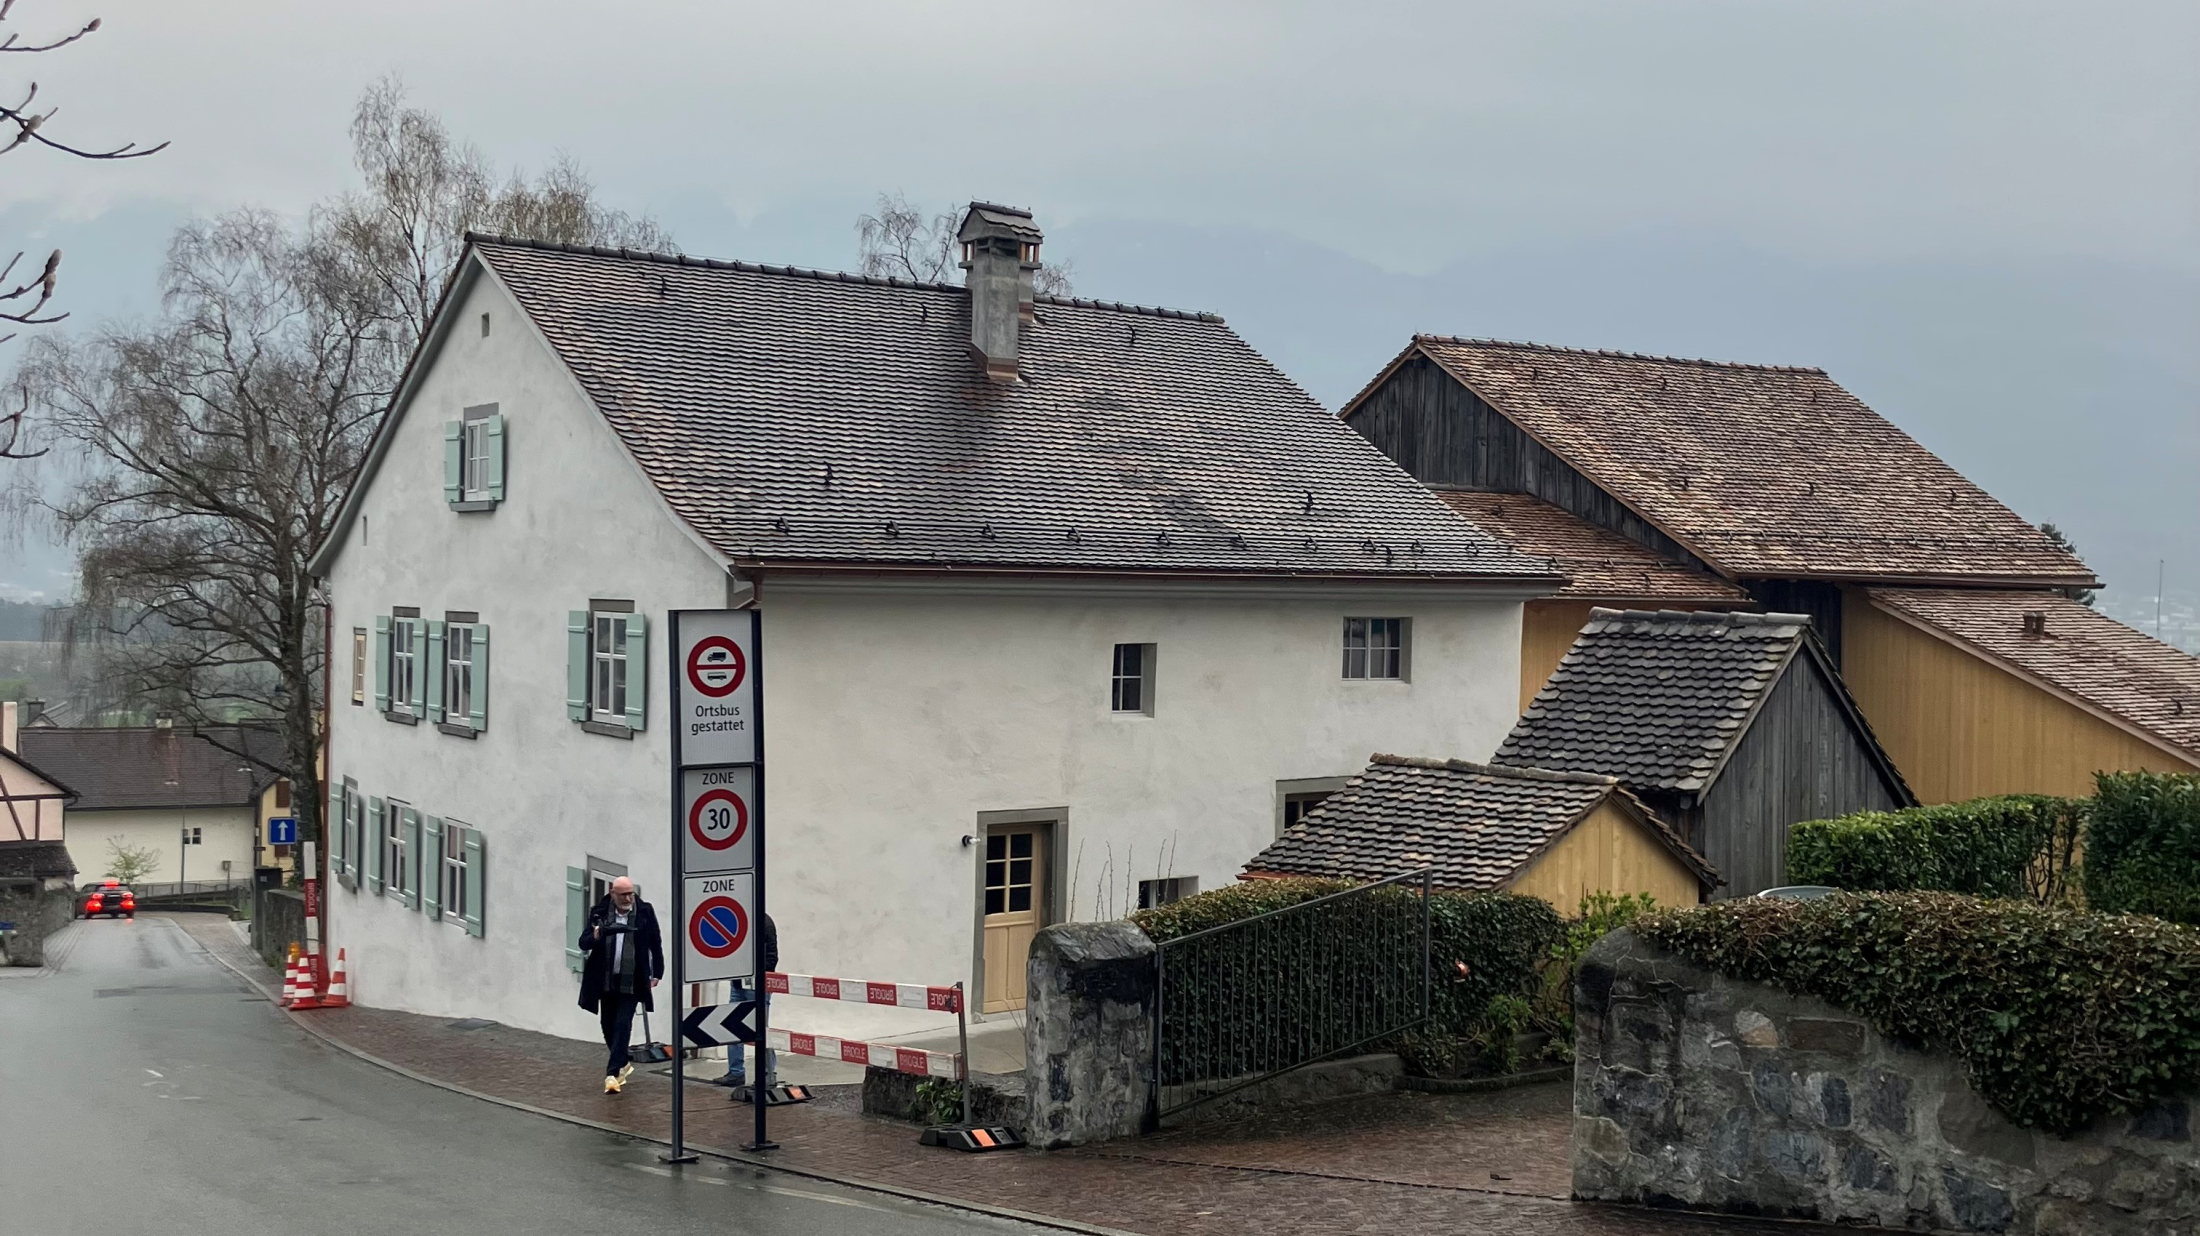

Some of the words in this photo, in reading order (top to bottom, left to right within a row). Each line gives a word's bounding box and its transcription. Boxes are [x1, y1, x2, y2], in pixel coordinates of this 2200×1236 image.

[695, 704, 740, 717] Ortsbus
[691, 719, 744, 736] gestattet
[702, 772, 735, 785] ZONE
[707, 807, 730, 831] 30
[702, 879, 735, 893] ZONE
[766, 977, 787, 990] BROGLE
[815, 982, 838, 995] BROGLE
[869, 987, 894, 1001] BROGLE
[792, 1037, 813, 1052] BROGLE
[843, 1044, 866, 1060] BROGLE
[900, 1054, 924, 1068] BROGLE
